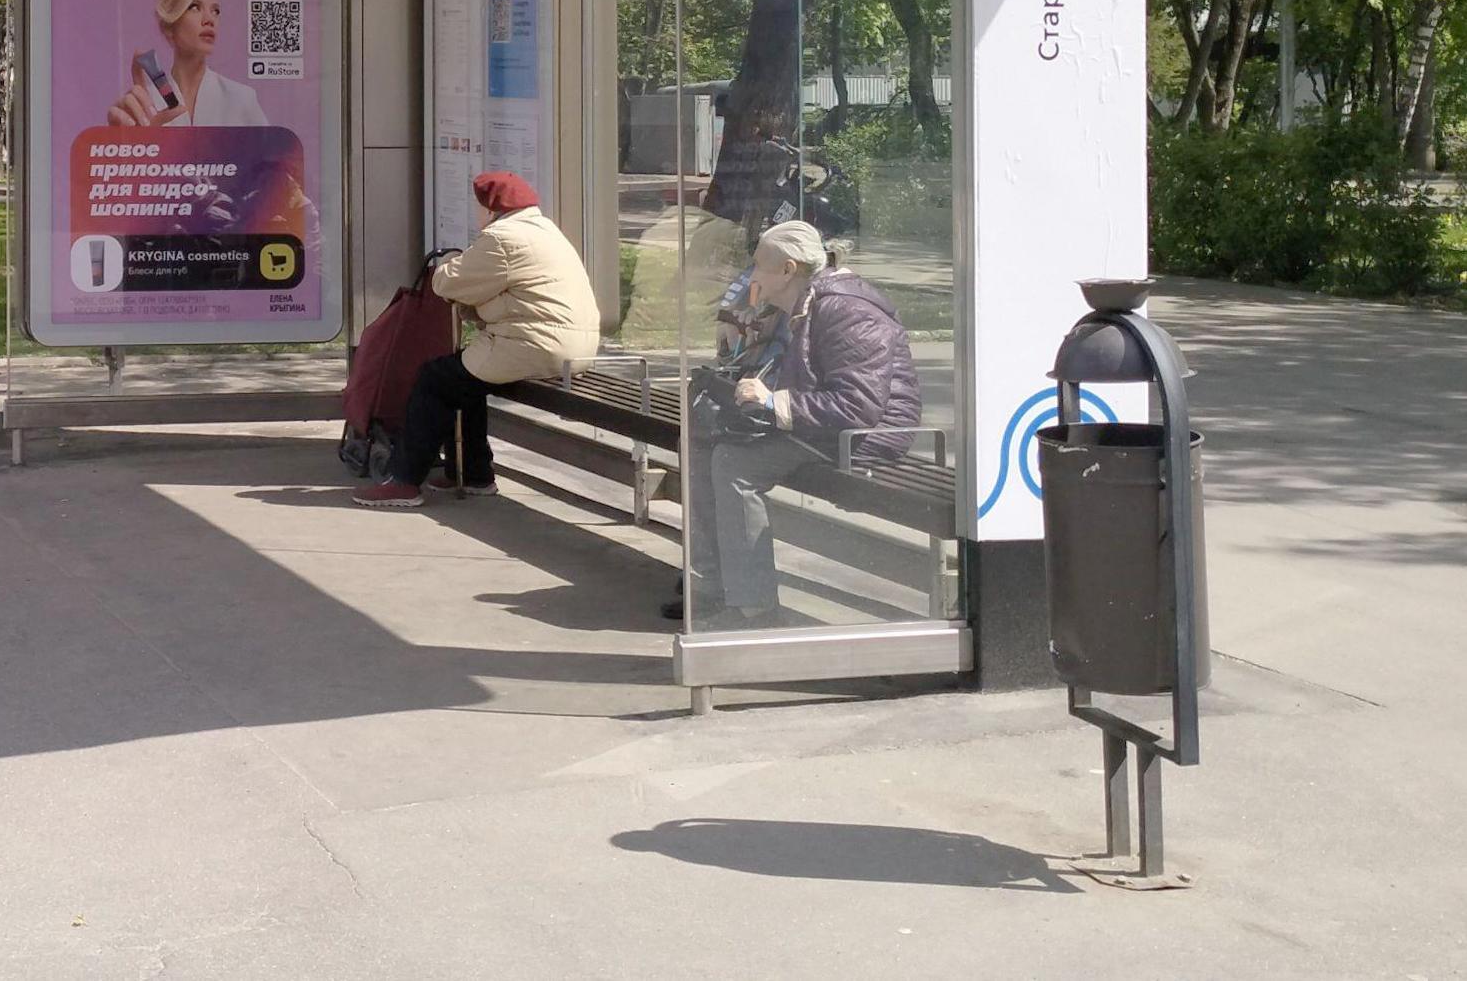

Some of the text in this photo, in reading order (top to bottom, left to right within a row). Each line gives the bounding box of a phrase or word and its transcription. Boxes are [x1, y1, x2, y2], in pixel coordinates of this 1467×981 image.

[89, 143, 160, 158] новое
[89, 162, 238, 182] приложение
[89, 182, 218, 200] для видео-
[89, 202, 193, 217] шопинга
[128, 249, 250, 262] KRYGINA cosmetics
